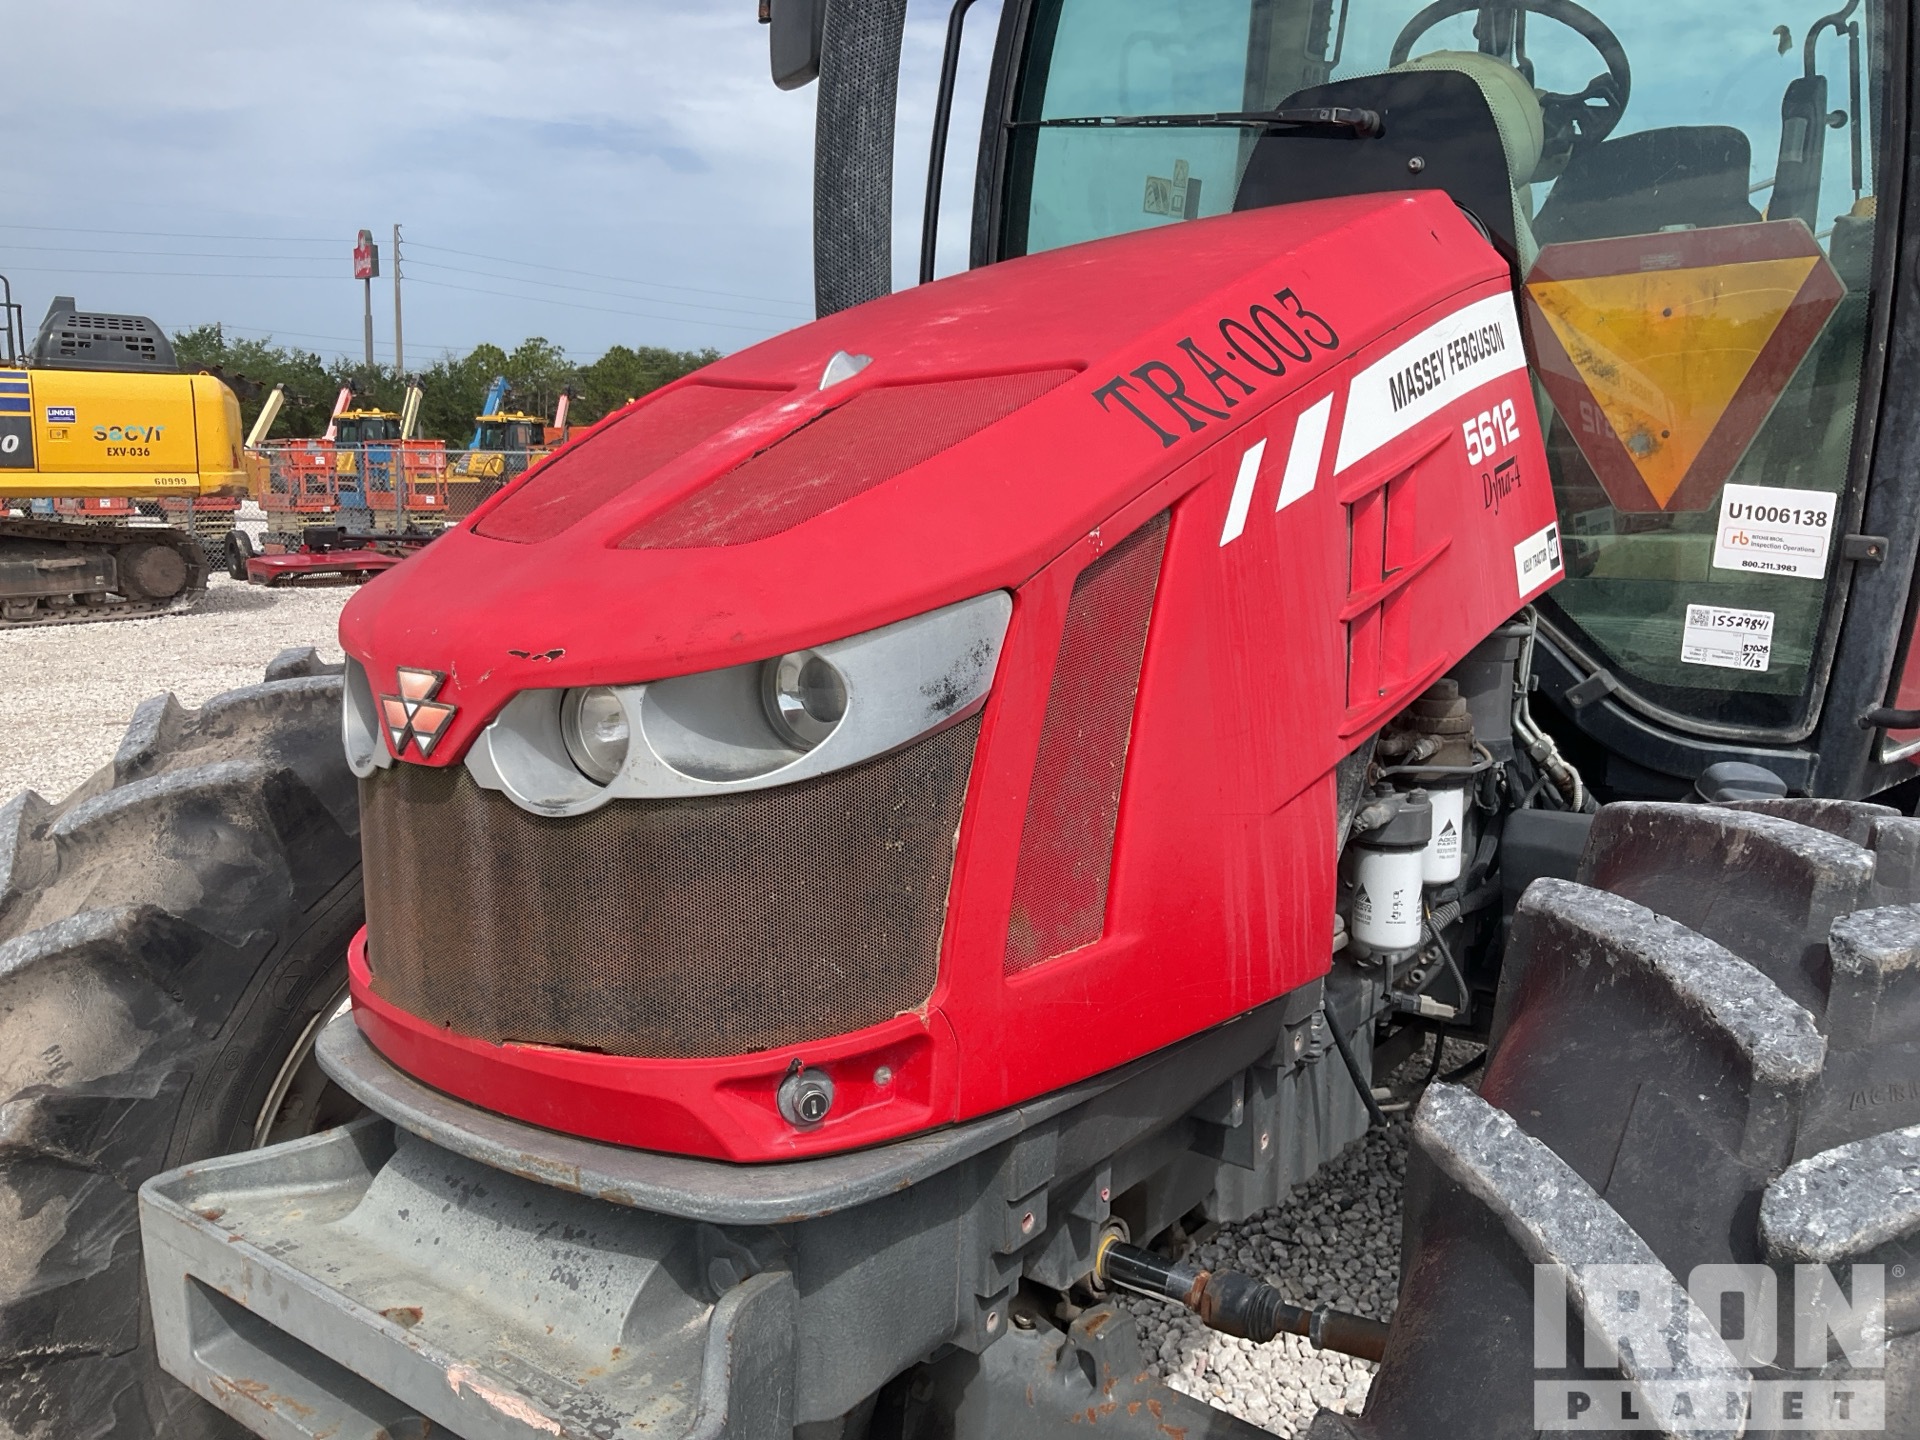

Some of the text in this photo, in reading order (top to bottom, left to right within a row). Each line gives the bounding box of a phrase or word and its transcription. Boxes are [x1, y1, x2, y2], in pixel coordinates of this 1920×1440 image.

[1388, 321, 1506, 413] MASSEY FERGUSON
[93, 425, 166, 443] sacyr
[1462, 398, 1520, 466] 5612
[107, 447, 150, 456] EXV-036
[1729, 503, 1828, 527] U1006138
[1732, 531, 1749, 545] rb
[1751, 541, 1815, 553] Inspection Operations
[1742, 560, 1797, 572] 800.211.3983
[1712, 614, 1769, 630] 15529841
[1742, 653, 1761, 668] 7/13
